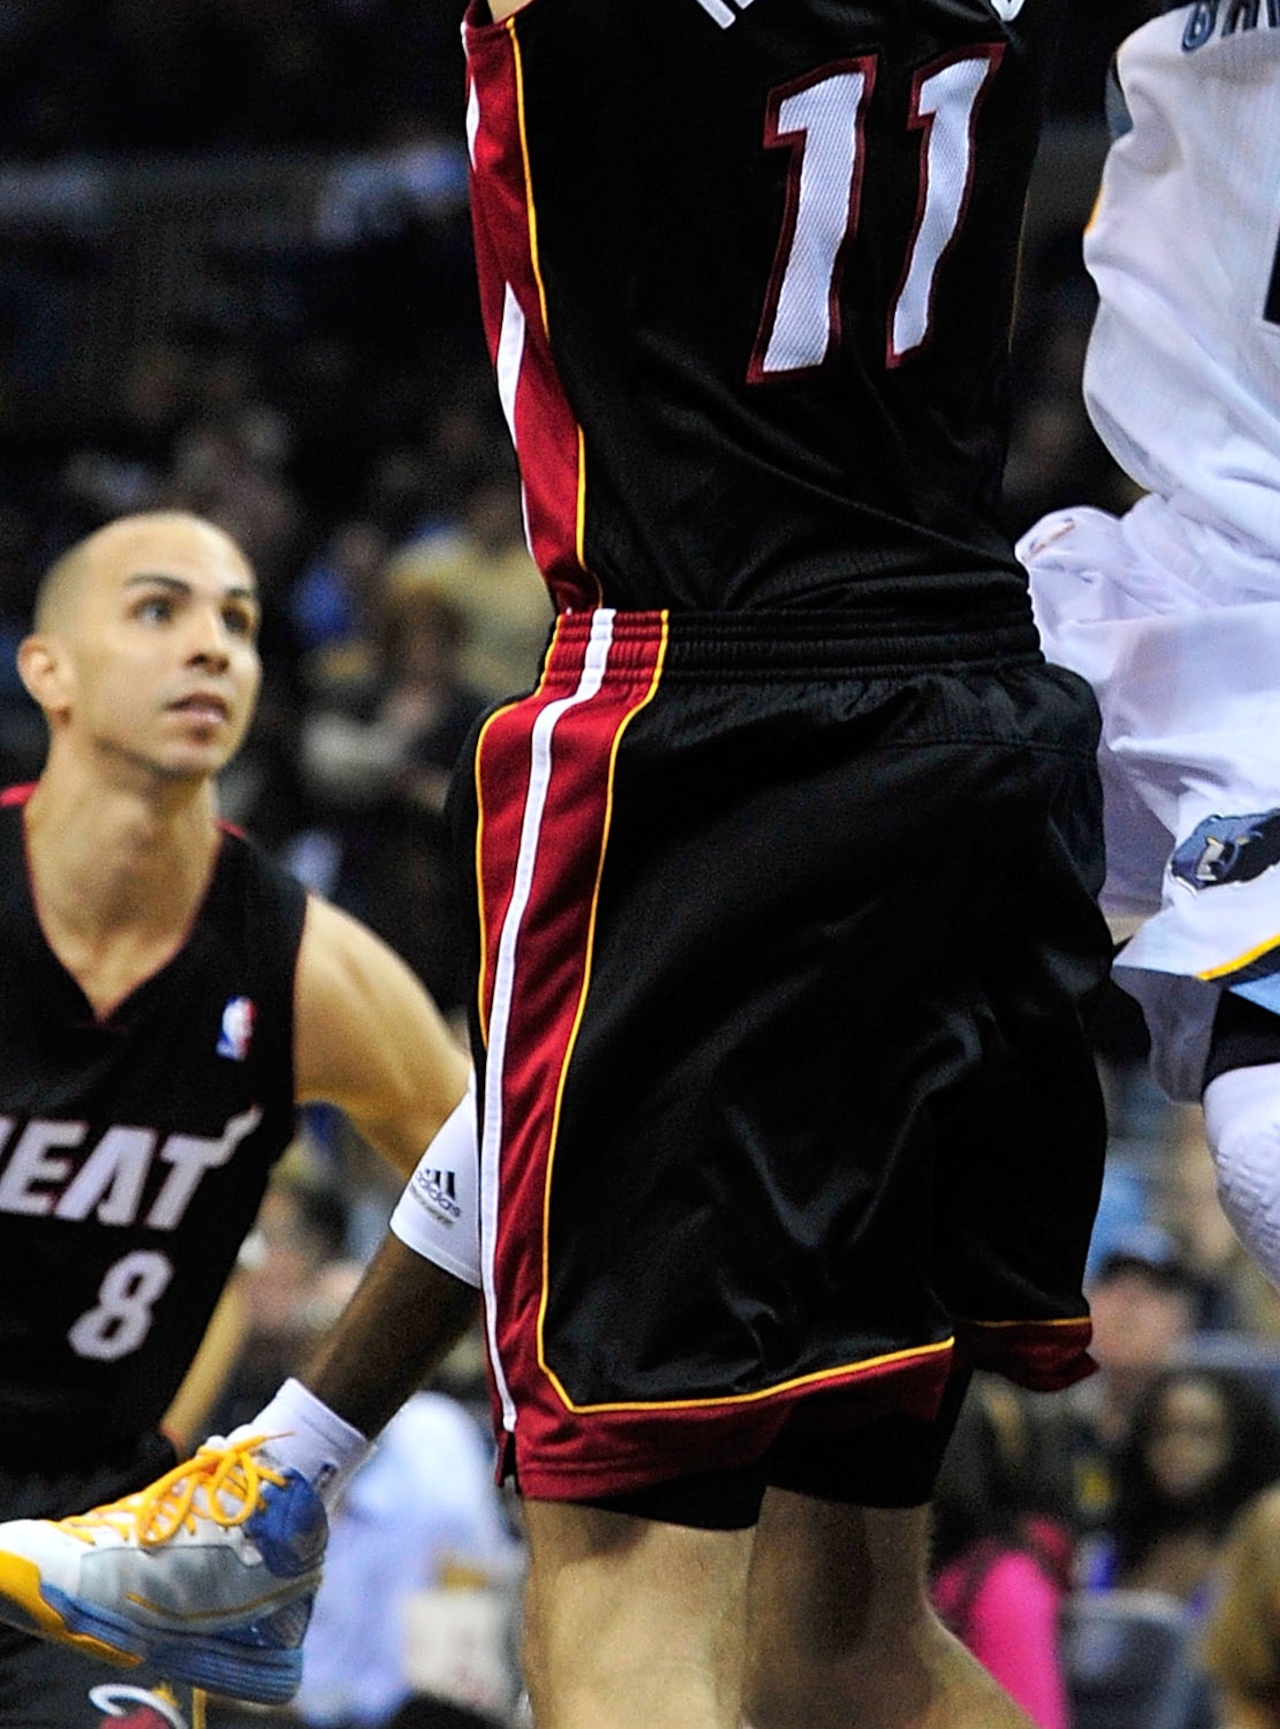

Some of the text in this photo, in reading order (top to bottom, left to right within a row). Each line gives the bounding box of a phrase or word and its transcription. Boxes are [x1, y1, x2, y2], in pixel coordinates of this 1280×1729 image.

[747, 43, 1006, 384] 11
[0, 1105, 263, 1231] EAT
[67, 1249, 175, 1362] 8
